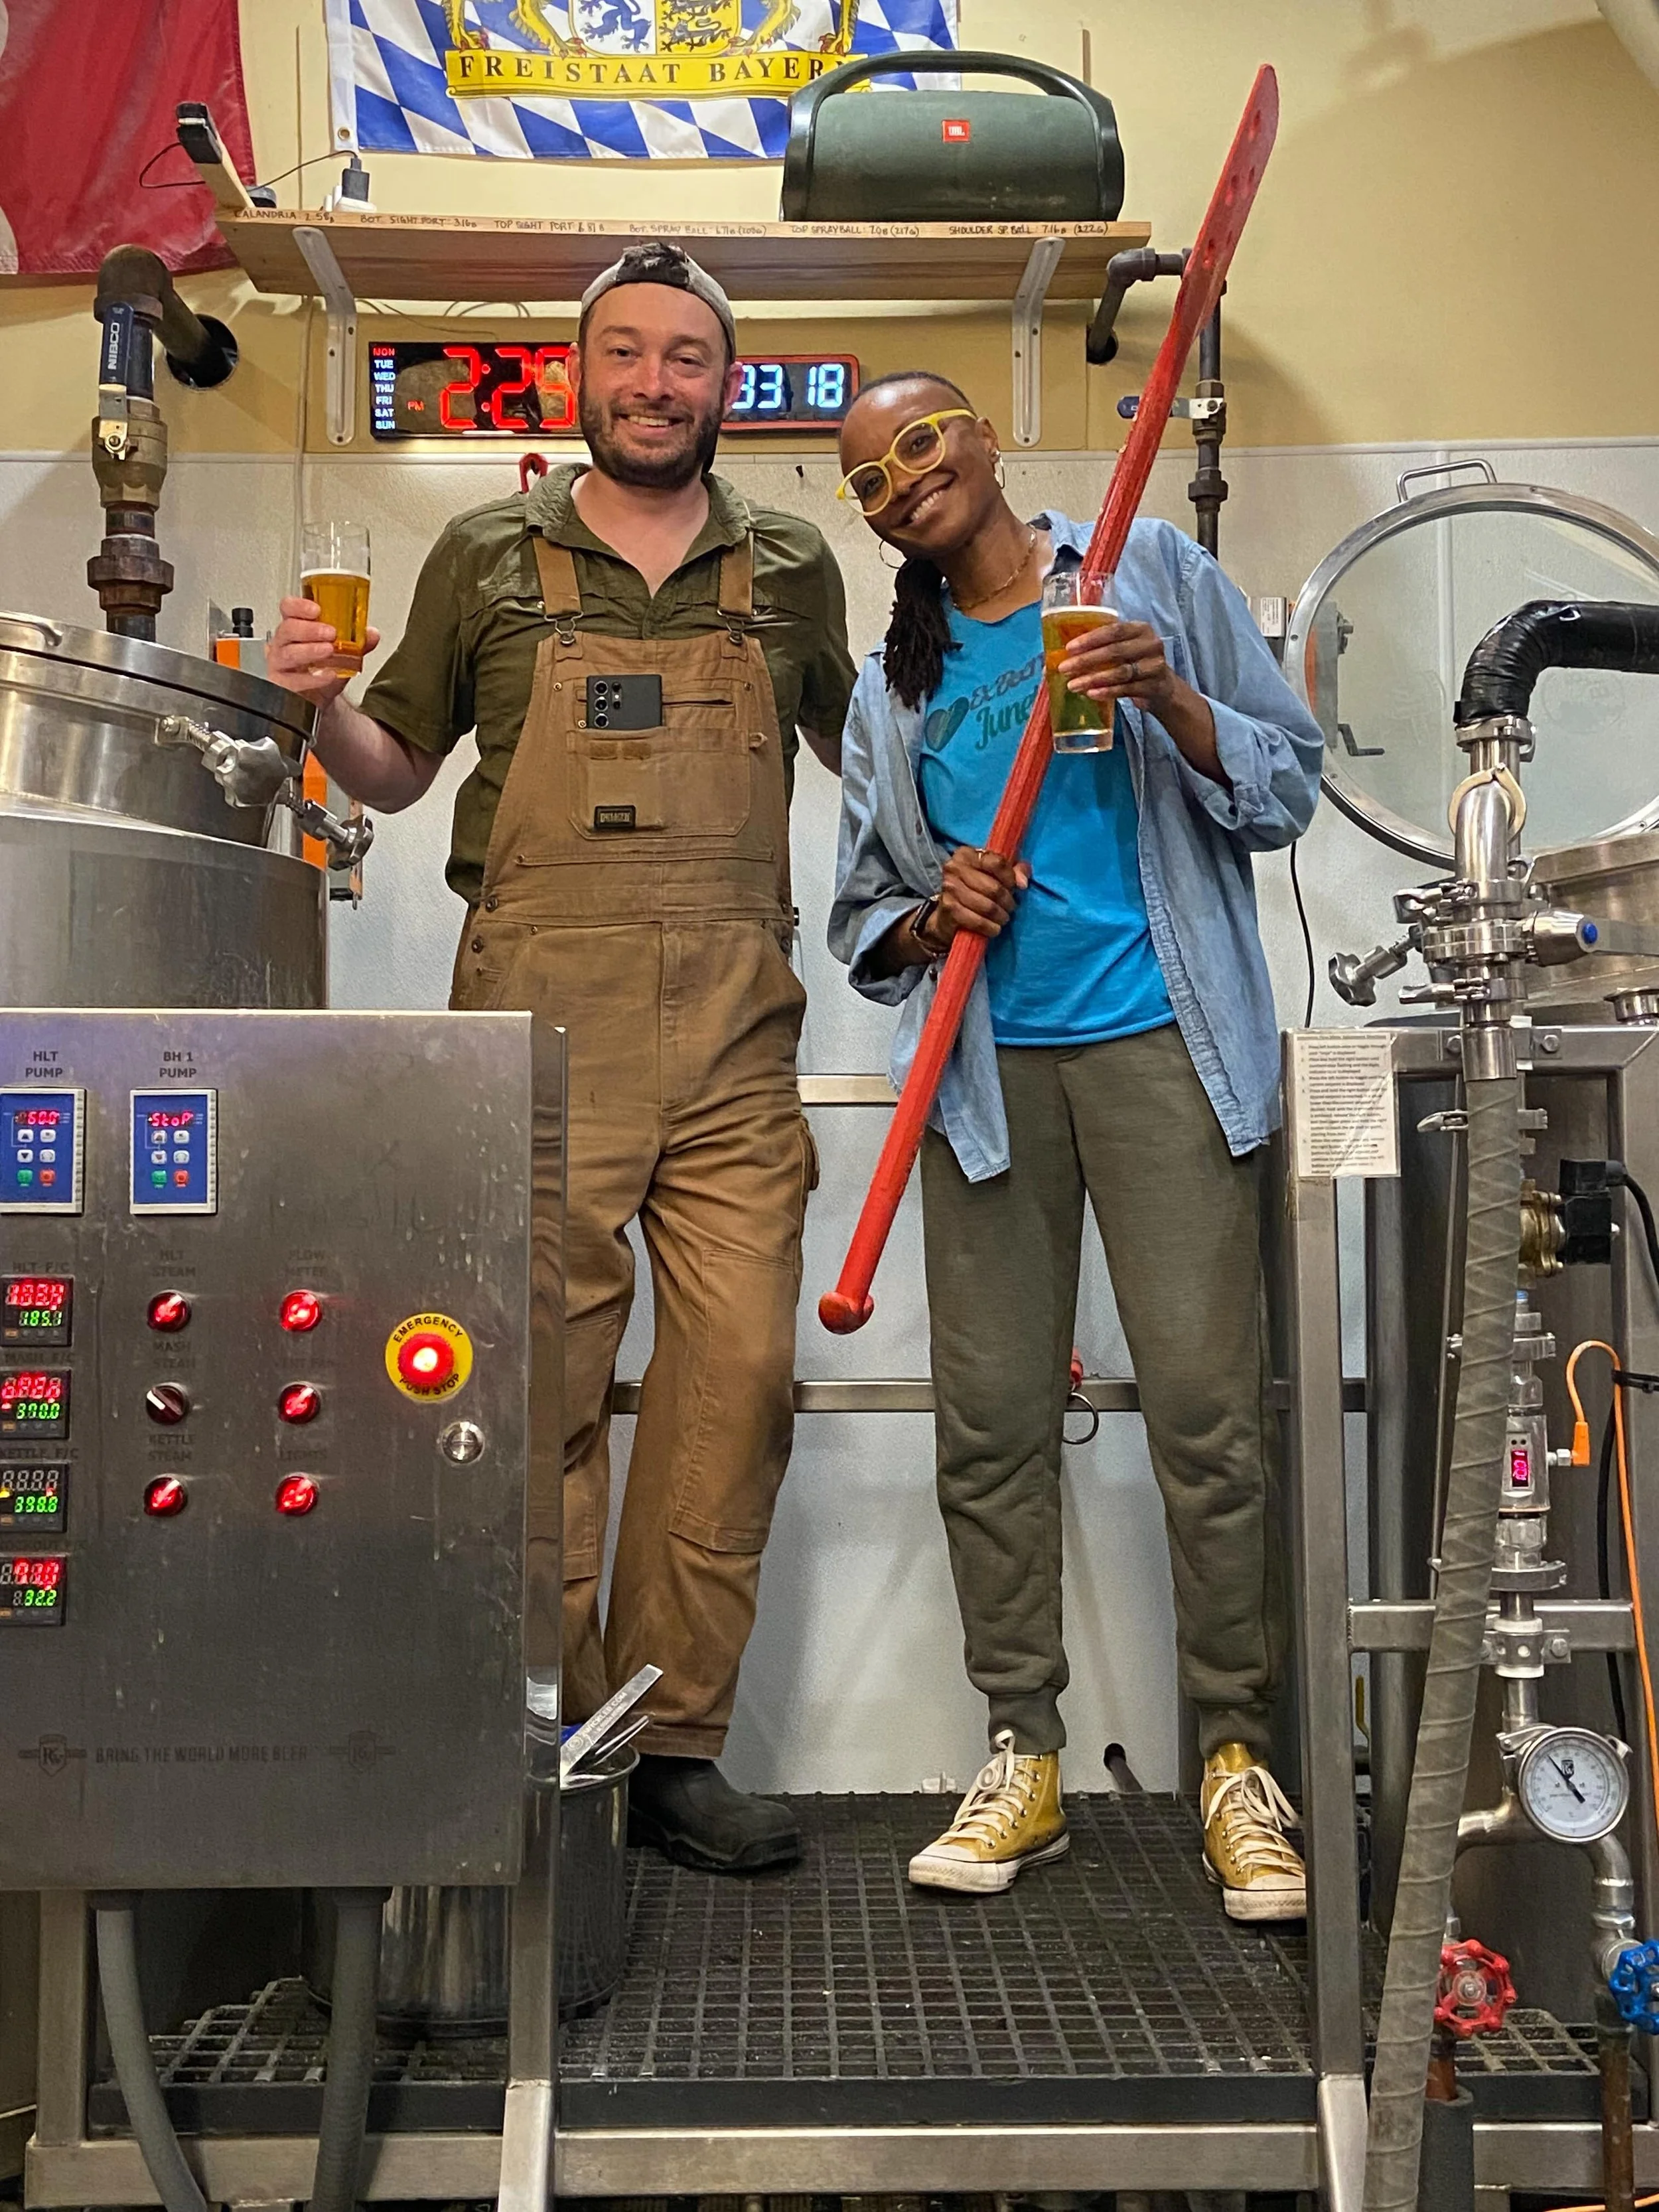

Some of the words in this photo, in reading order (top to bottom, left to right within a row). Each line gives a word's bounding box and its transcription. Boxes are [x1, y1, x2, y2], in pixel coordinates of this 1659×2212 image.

[459, 55, 681, 84] FREISTAAT
[709, 57, 843, 82] BAYER
[234, 210, 297, 220] CALANDRIA
[390, 216, 417, 224] SIGHT
[494, 220, 513, 229] TOP
[549, 221, 574, 231] PORT
[789, 224, 808, 233] TOP
[949, 225, 993, 235] SHOULDER
[108, 322, 121, 370] NIBCO
[373, 347, 396, 356] MON
[374, 359, 394, 370] TUE
[373, 372, 396, 382] WED
[375, 383, 395, 394] THU
[439, 346, 576, 429] 2:25
[807, 363, 845, 409] 18
[376, 396, 393, 406] FRI
[407, 400, 425, 411] PM
[374, 408, 394, 418] SAT
[375, 420, 396, 429] SUN
[33, 1051, 58, 1062] HLT
[163, 1051, 182, 1062] BH
[186, 1051, 194, 1062] 1
[25, 1068, 63, 1078] PUMP
[159, 1068, 197, 1078] PUMP
[159, 1250, 184, 1261] HLT
[151, 1266, 196, 1278] STEAM
[393, 1316, 463, 1343] EMERGENCY
[153, 1341, 191, 1352] MASH
[399, 1377, 430, 1396] PUSH
[433, 1373, 460, 1395] STOP
[149, 1434, 195, 1445] KETTLE
[147, 1450, 192, 1462] STEAM
[96, 1746, 139, 1763] BRING
[144, 1746, 171, 1763] THE
[175, 1745, 224, 1763] WORLD
[228, 1745, 267, 1763] MORE
